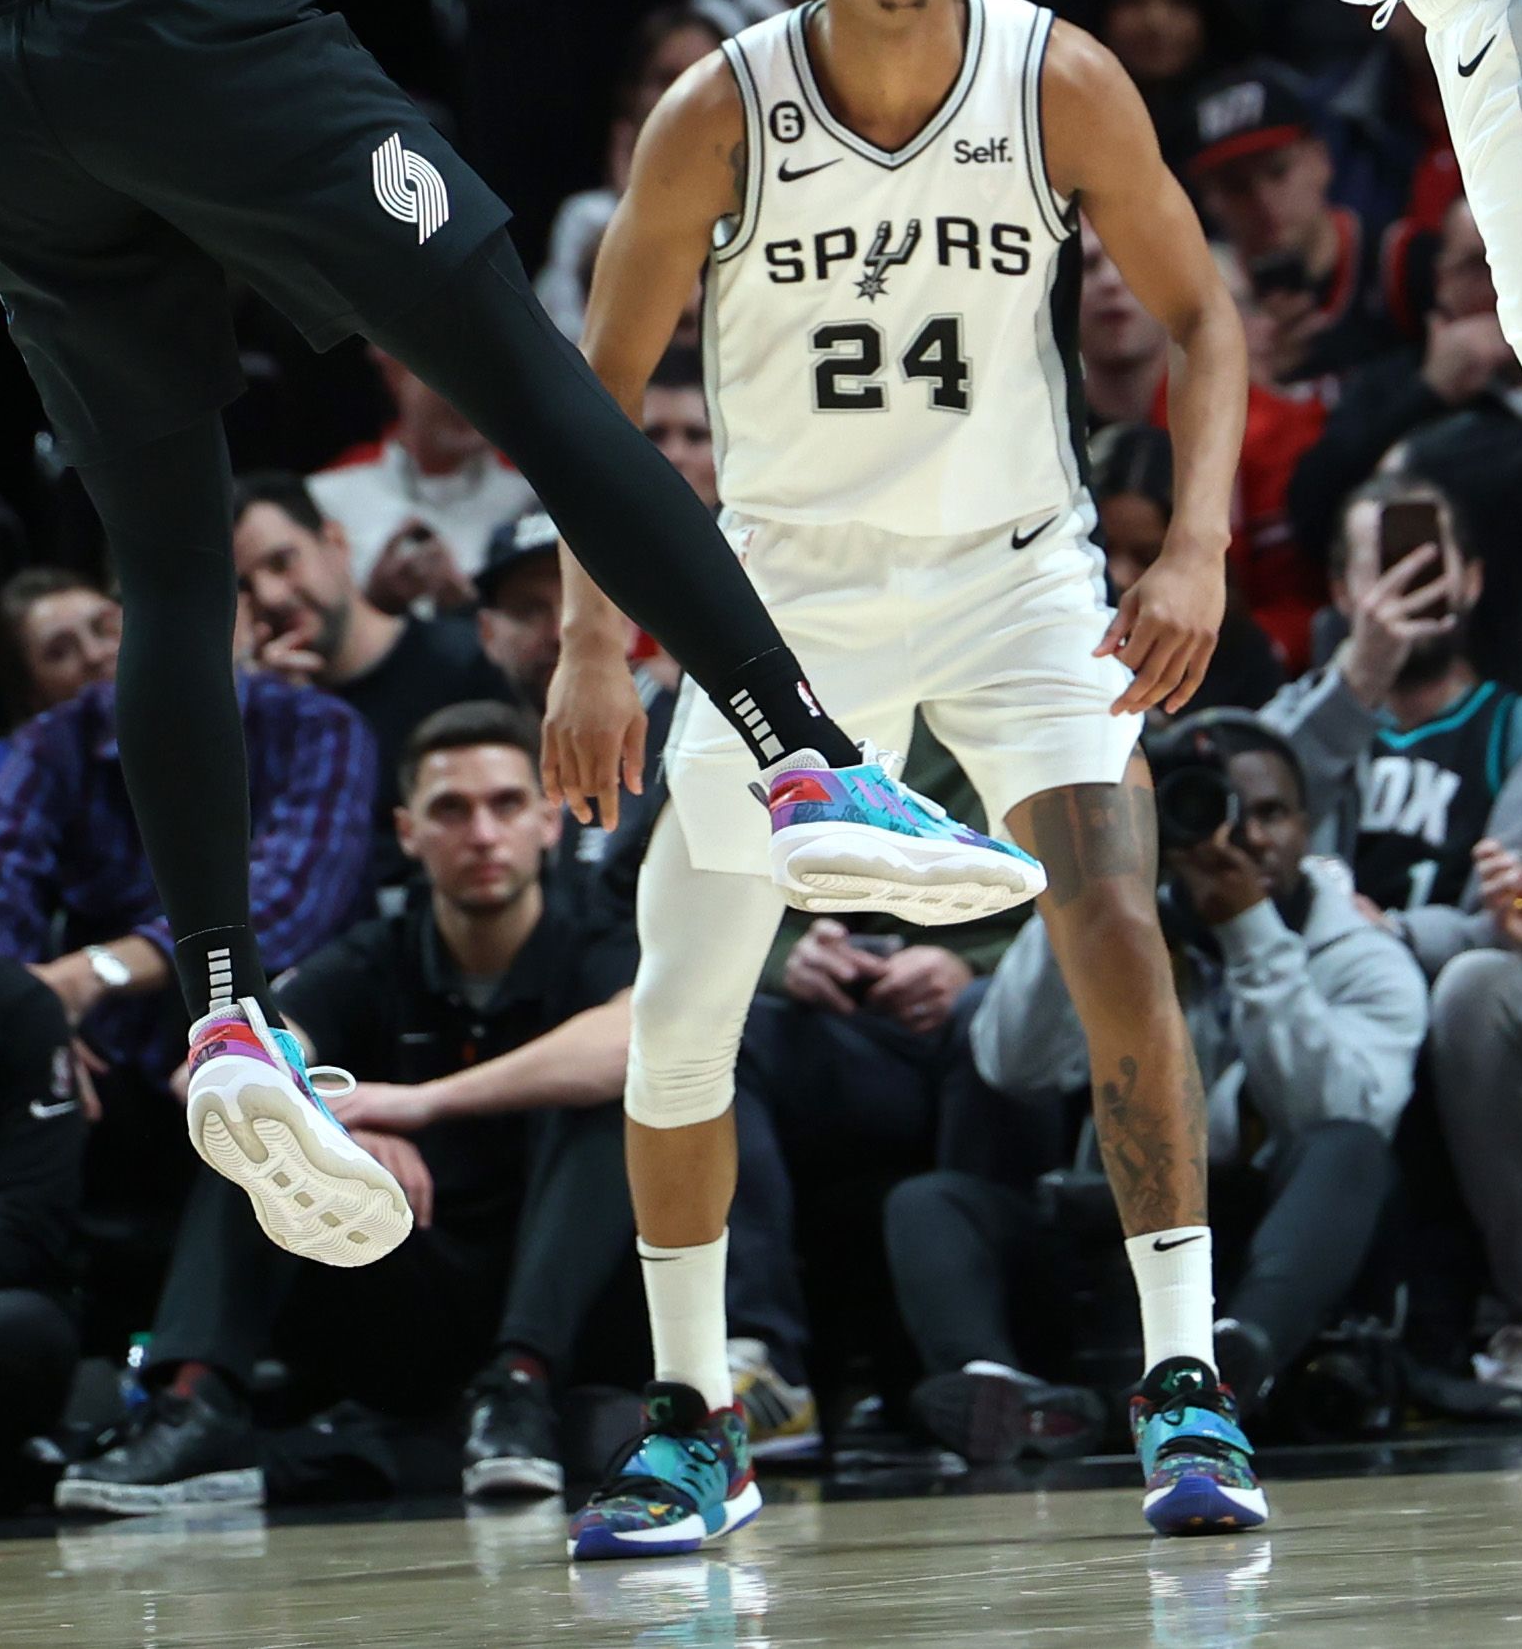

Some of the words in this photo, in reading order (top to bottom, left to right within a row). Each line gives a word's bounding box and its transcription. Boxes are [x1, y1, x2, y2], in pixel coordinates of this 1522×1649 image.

[774, 107, 800, 140] 6
[954, 137, 1013, 164] Self.
[765, 217, 1031, 303] SPURS
[808, 312, 973, 415] 24
